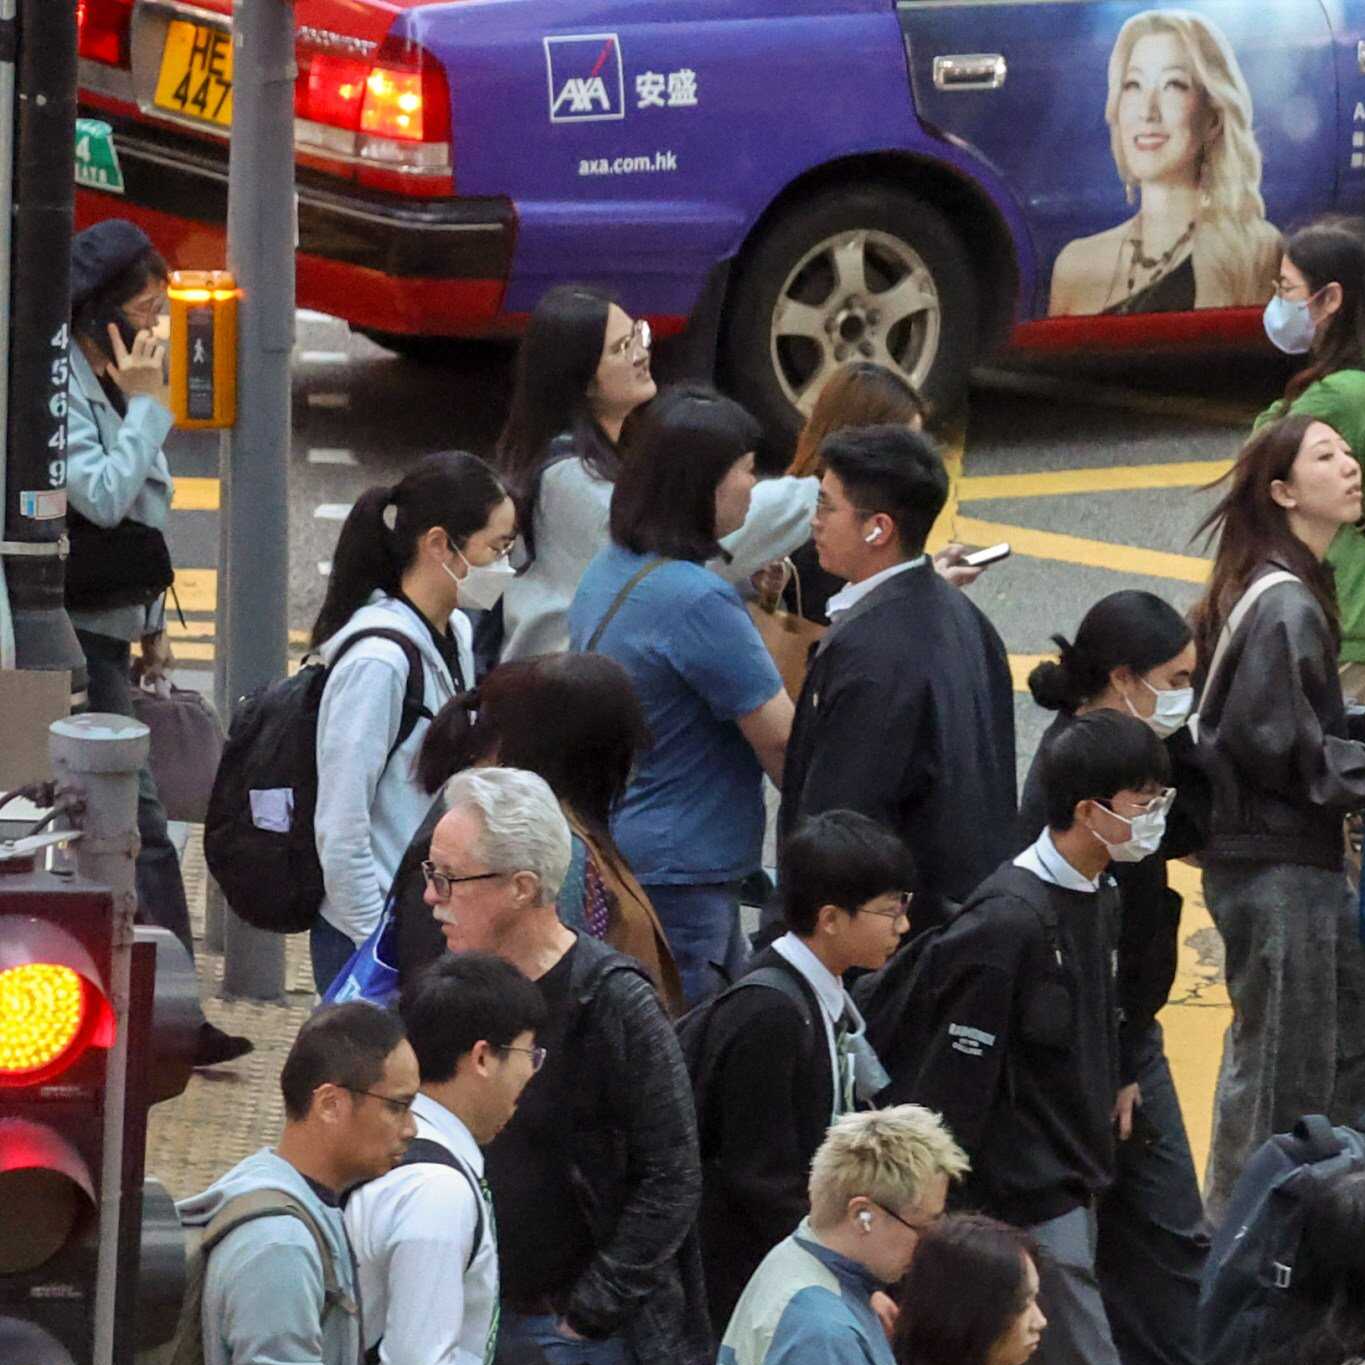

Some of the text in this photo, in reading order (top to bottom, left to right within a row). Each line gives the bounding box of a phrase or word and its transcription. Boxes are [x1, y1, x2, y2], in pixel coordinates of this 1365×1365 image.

[552, 68, 698, 113] AXA 安盛
[578, 150, 677, 175] axa.com.hk
